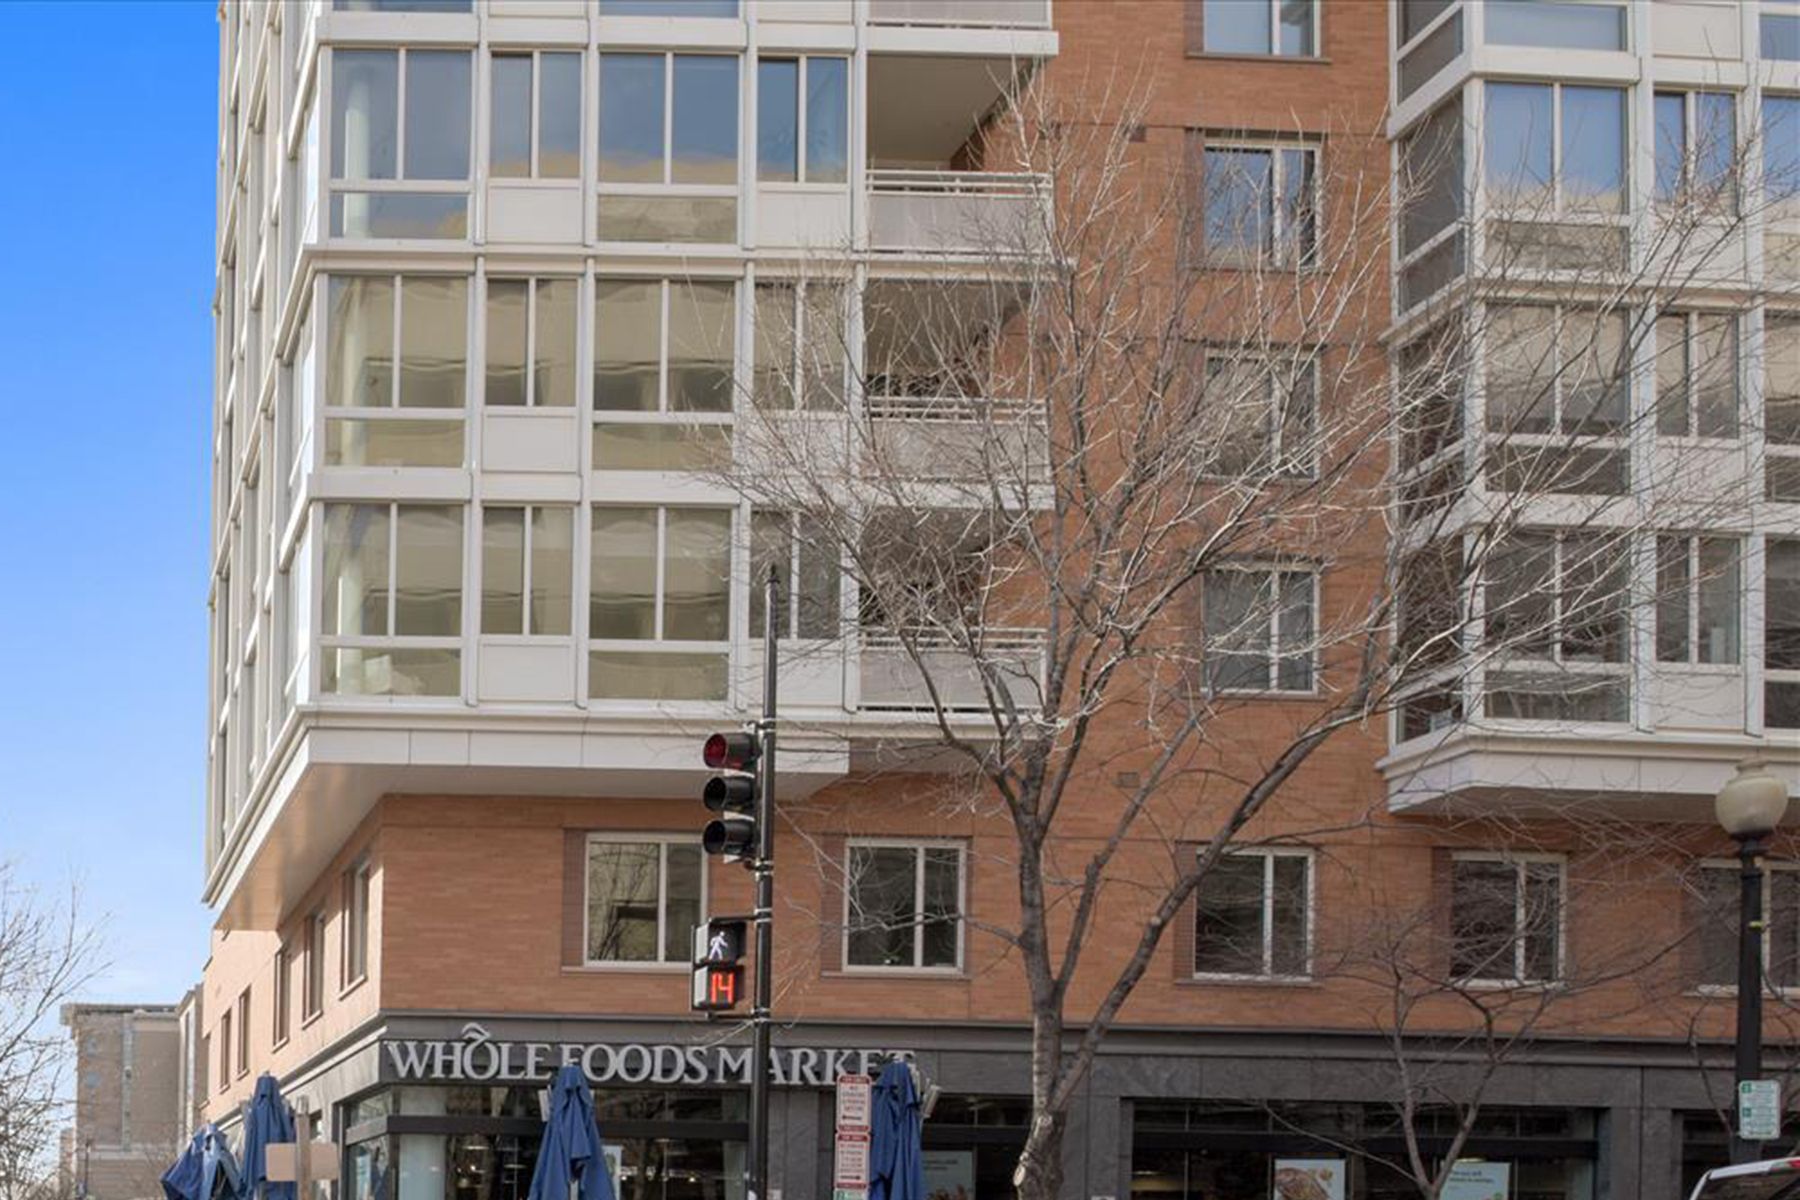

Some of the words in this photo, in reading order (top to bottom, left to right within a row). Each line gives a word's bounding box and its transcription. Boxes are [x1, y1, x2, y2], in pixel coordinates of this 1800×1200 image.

[711, 971, 735, 1004] 14
[383, 1023, 552, 1080] WHOLE
[560, 1043, 708, 1084] FOODS
